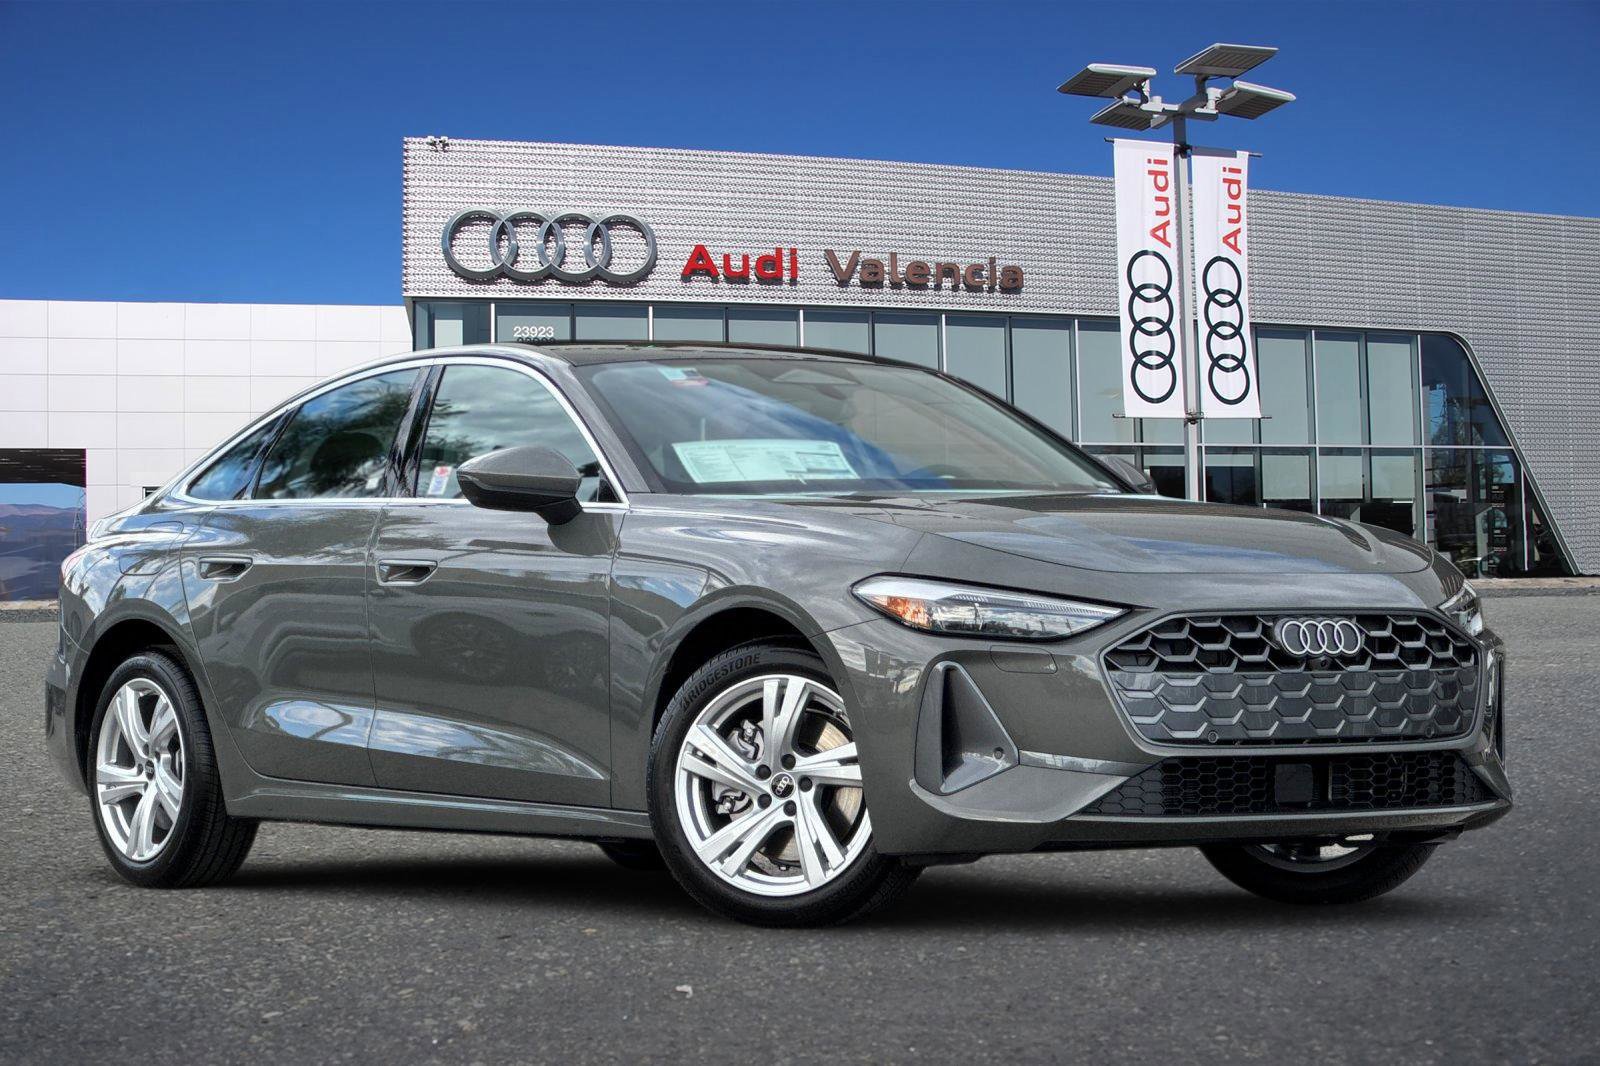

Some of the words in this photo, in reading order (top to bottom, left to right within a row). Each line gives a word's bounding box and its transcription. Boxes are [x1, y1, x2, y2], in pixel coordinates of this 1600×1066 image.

[1147, 158, 1172, 249] Audi
[1222, 166, 1242, 256] Audi
[681, 244, 799, 282] Audi
[824, 249, 1025, 290] Valencia
[513, 326, 554, 337] 23923
